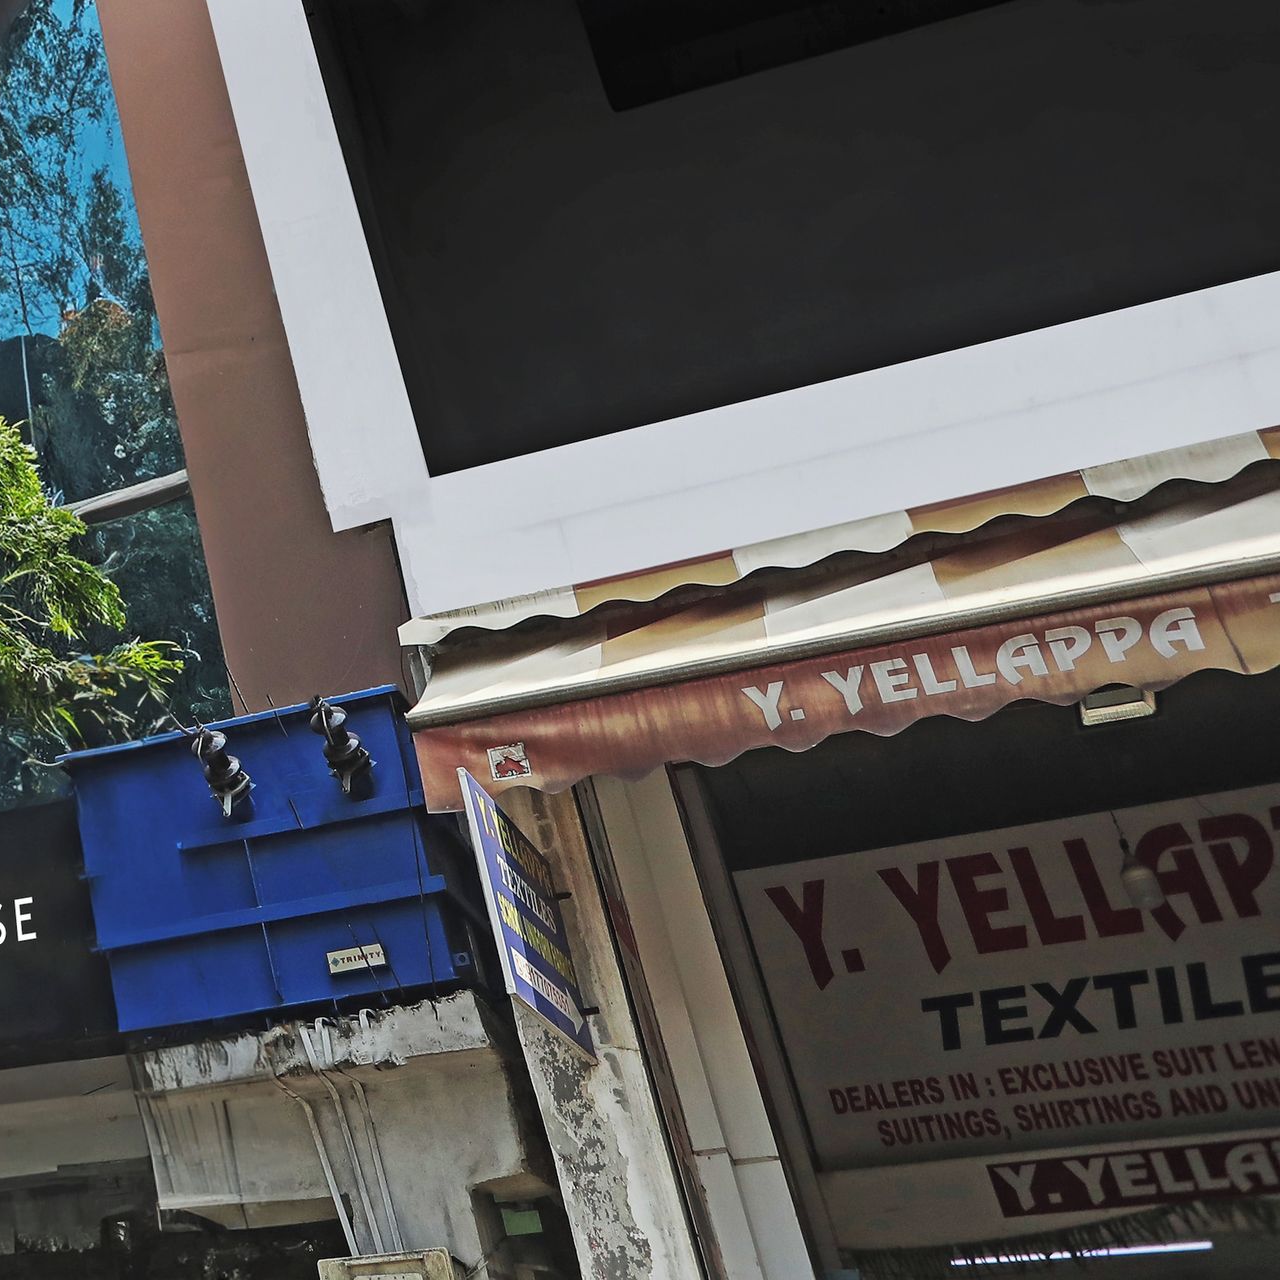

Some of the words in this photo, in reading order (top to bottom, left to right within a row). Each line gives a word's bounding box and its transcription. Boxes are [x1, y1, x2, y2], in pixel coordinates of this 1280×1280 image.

[741, 680, 806, 732] Y.
[821, 606, 1206, 716] YELLAPPA
[496, 852, 557, 935] TEXTILES
[876, 806, 1280, 976] YELLAP
[920, 951, 1280, 1051] TEXTILE
[828, 1077, 945, 1115] DEALERS
[948, 1072, 980, 1102] IN
[996, 1052, 1148, 1096] EXCLUSIVE
[1152, 1044, 1218, 1079] SUIT
[877, 1107, 1012, 1147] SUITINGS,
[1012, 1090, 1163, 1133] SHIRTINGS
[1169, 1083, 1228, 1118] AND
[1061, 1140, 1280, 1207] YELLA
